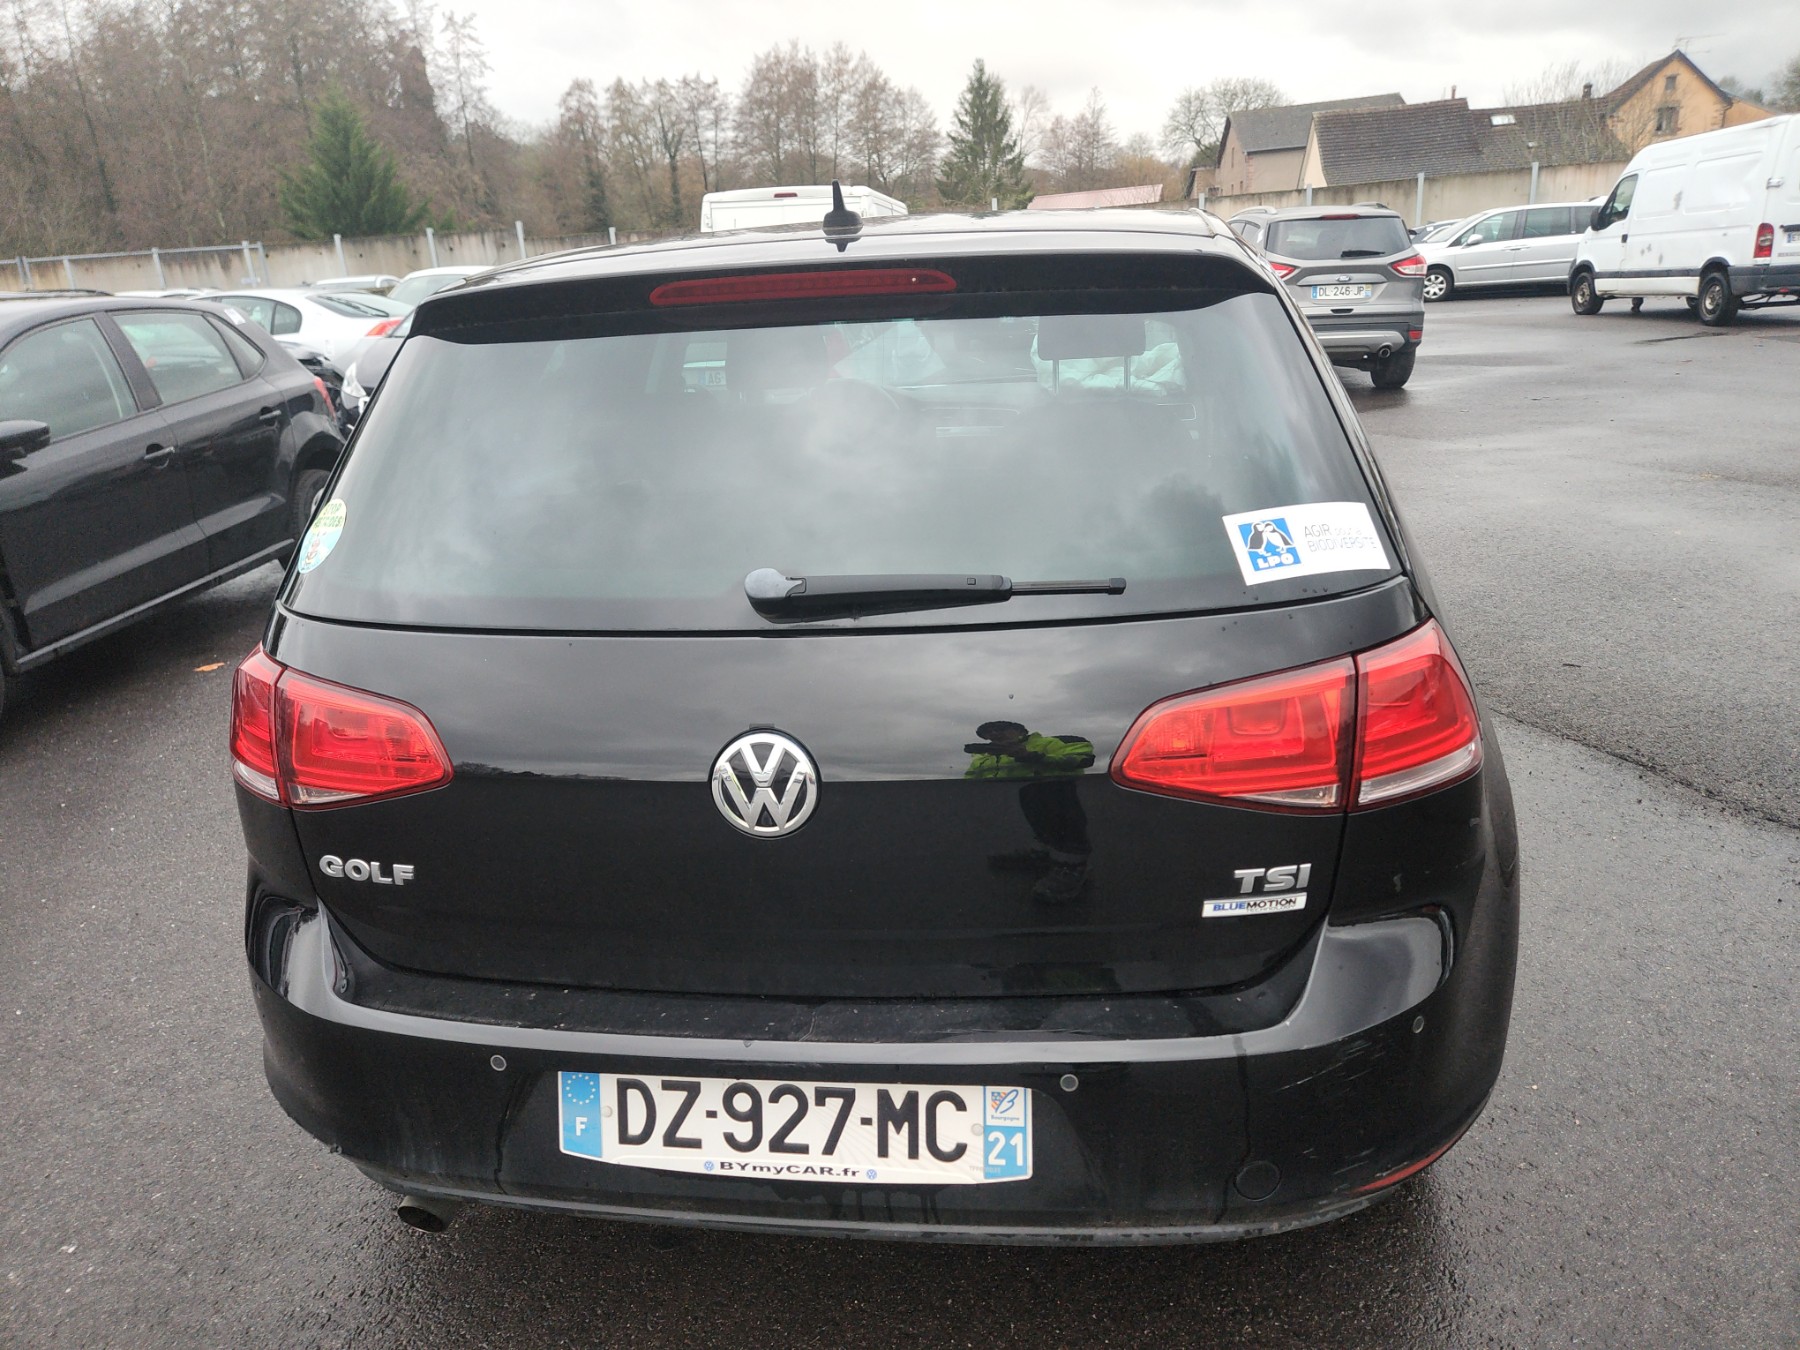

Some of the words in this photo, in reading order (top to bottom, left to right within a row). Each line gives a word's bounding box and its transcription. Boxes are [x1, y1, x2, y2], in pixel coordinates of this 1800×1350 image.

[1318, 286, 1364, 297] DL-246-JP
[1304, 523, 1331, 538] AGIR
[1257, 553, 1294, 569] LPO
[319, 855, 415, 885] GOLF
[1233, 863, 1312, 894] TSI
[1213, 898, 1297, 912] BLUEMOTION
[575, 1116, 588, 1136] F
[616, 1077, 967, 1162] DZ-927-MC
[987, 1131, 1024, 1167] 21
[719, 1161, 860, 1177] BYmyCAR.fr
